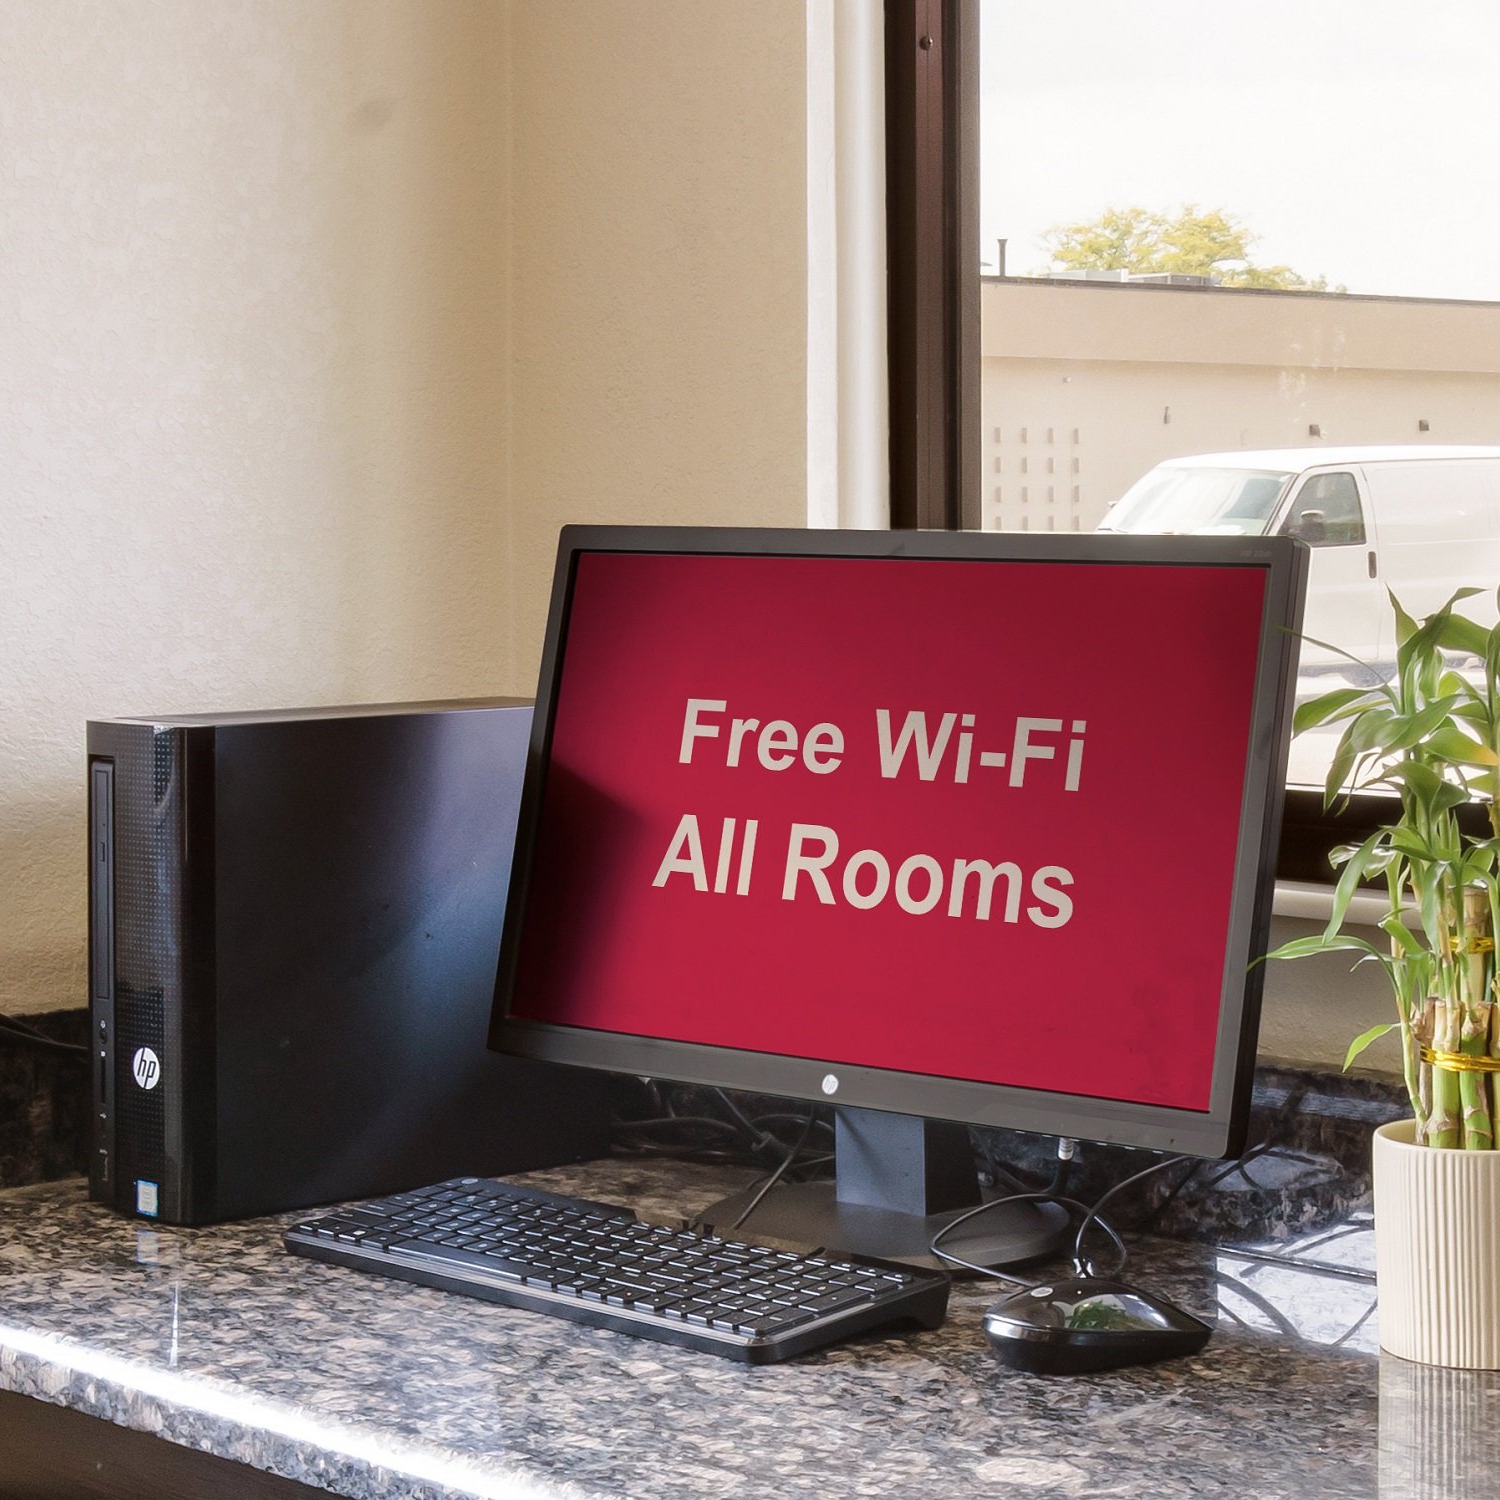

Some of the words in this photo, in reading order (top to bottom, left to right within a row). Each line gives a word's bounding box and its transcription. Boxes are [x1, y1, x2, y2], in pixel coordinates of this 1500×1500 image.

[678, 698, 846, 775] Free
[876, 708, 1087, 792] Wi-Fi
[651, 813, 759, 896] All
[781, 822, 1076, 929] Rooms
[136, 1047, 157, 1089] hp
